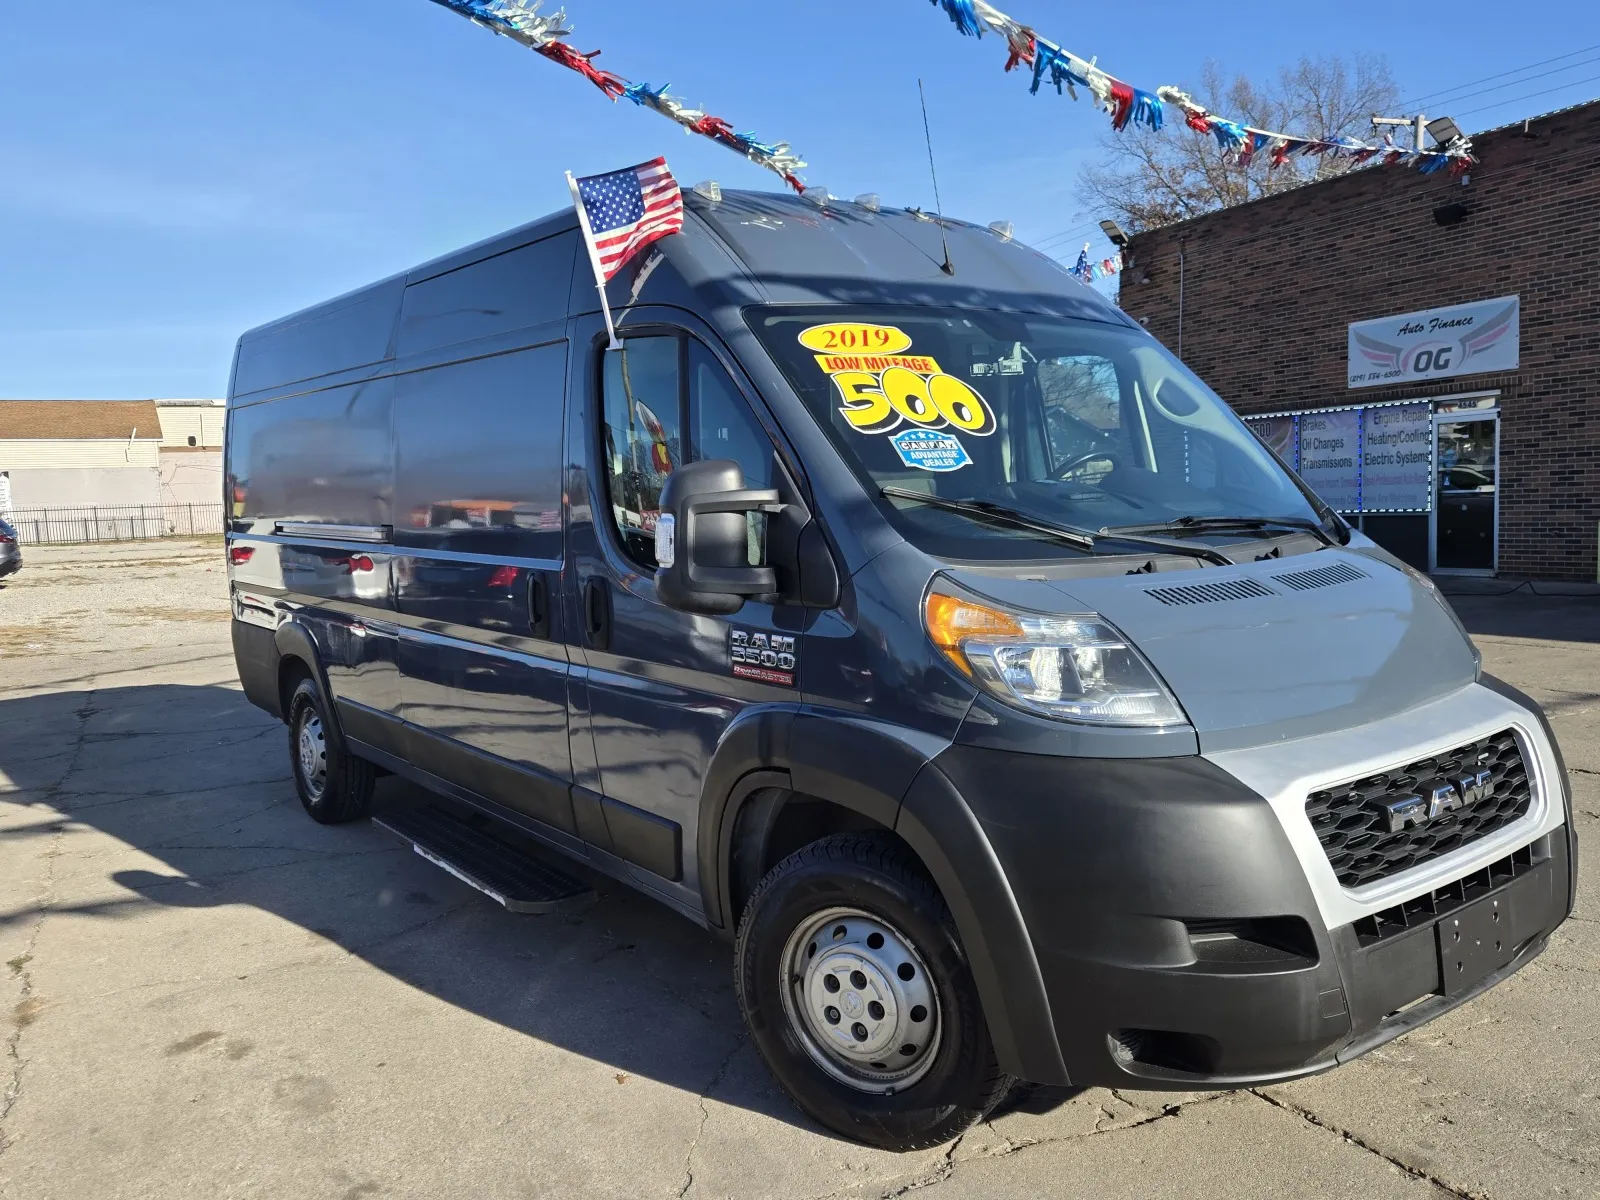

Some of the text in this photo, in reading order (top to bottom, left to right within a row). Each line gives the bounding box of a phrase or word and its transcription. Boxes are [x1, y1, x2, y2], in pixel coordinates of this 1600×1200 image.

[1396, 317, 1474, 336] Auto Finance
[822, 329, 890, 348] 2019
[825, 357, 862, 370] LOW
[1413, 346, 1454, 373] OG
[831, 366, 996, 436] 500
[1302, 419, 1326, 431] Brakes
[1373, 408, 1430, 427] Engine Repair
[1249, 422, 1271, 438] 500
[901, 441, 957, 450] CARFAX
[1302, 438, 1344, 452] Oil Changes
[910, 450, 959, 459] ADVANTAGE
[922, 459, 956, 467] DEALER
[1364, 450, 1430, 467] Electric Systems
[1302, 457, 1353, 470] Transmissions
[732, 630, 795, 653] RAM
[732, 647, 795, 669] 3500
[1387, 769, 1494, 833] RAM
